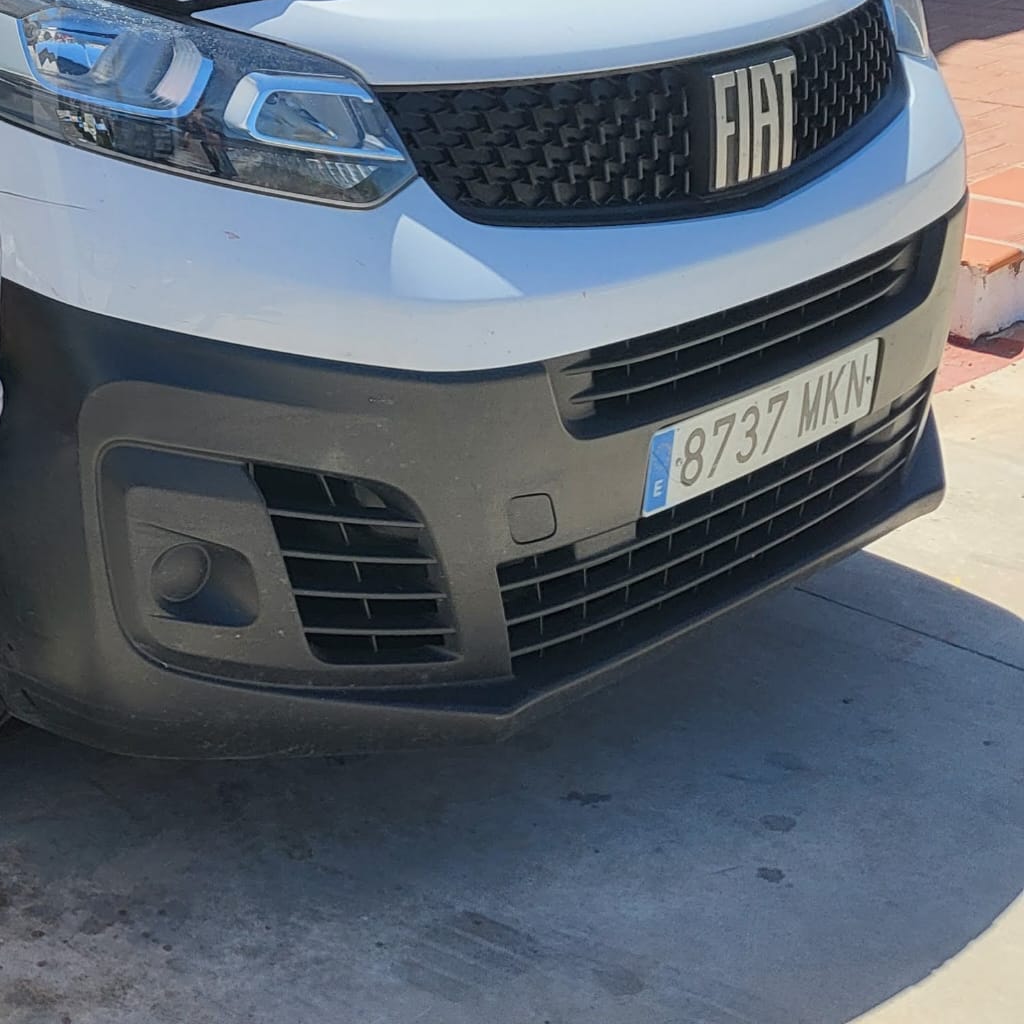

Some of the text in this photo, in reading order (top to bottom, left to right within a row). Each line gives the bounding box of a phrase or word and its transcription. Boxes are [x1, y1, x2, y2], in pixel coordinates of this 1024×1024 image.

[712, 55, 798, 190] FIAT
[680, 353, 869, 487] 8737 MKN
[652, 479, 664, 498] E
